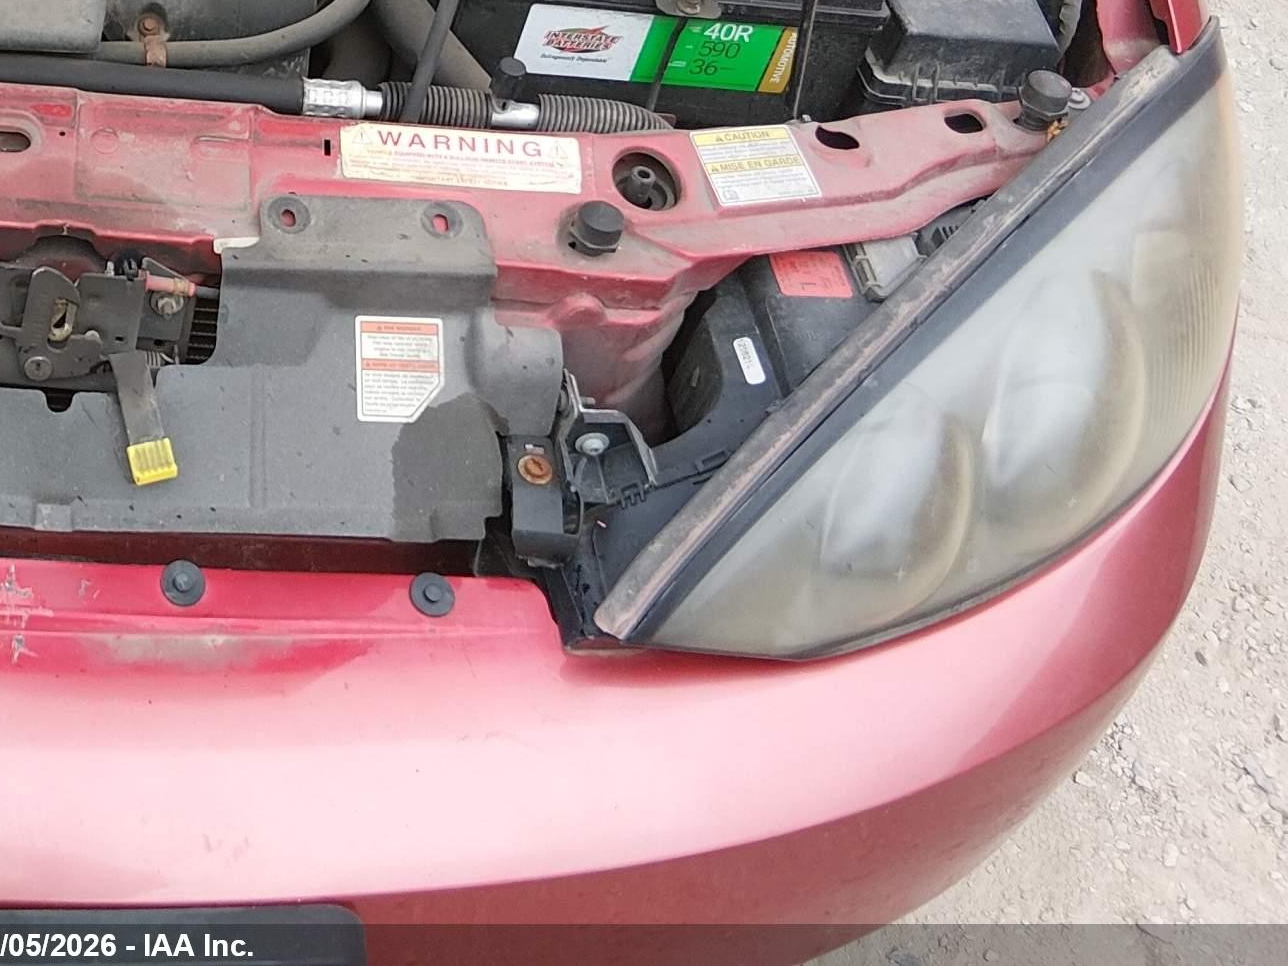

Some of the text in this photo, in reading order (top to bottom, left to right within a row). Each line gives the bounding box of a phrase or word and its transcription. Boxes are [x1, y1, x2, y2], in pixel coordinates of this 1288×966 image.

[544, 30, 623, 45] INTERSTATE
[704, 22, 753, 43] 40R
[543, 38, 616, 51] BATTERIES
[698, 40, 741, 59] 590
[689, 58, 719, 76] 36
[377, 129, 543, 157] WARNING
[724, 129, 770, 142] CAUTION
[720, 155, 800, 171] MISE EN GARDE
